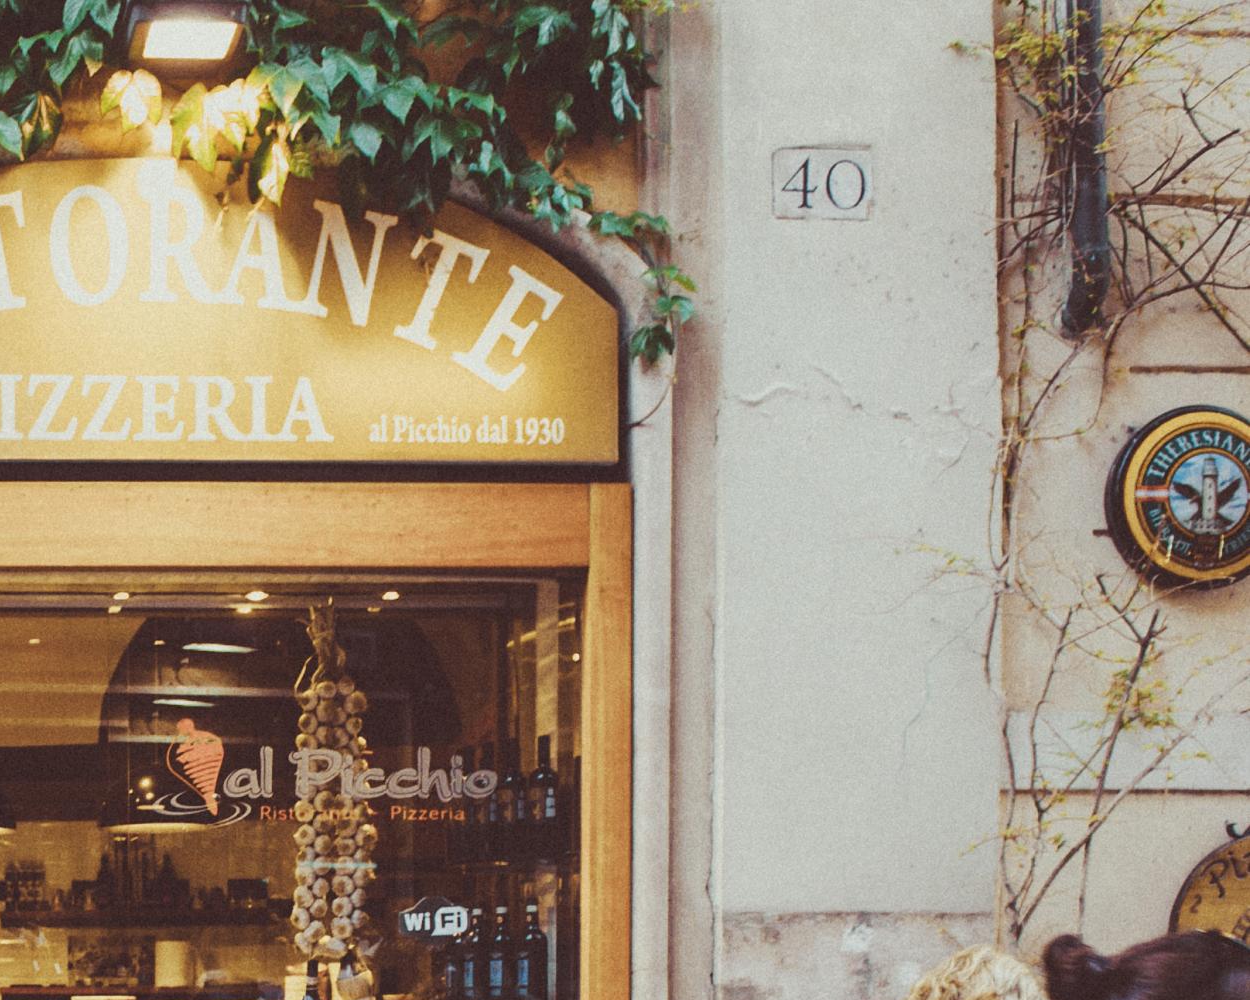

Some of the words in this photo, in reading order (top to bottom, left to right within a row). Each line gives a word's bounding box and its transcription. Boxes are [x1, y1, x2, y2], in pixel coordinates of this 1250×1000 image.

[781, 157, 866, 210] 40
[369, 415, 388, 443] al
[393, 415, 471, 443] Picchio
[476, 415, 509, 444] dal
[514, 416, 565, 445] 1930
[223, 745, 274, 799] al
[288, 745, 498, 802] Picchio
[390, 805, 465, 821] Pizzeria
